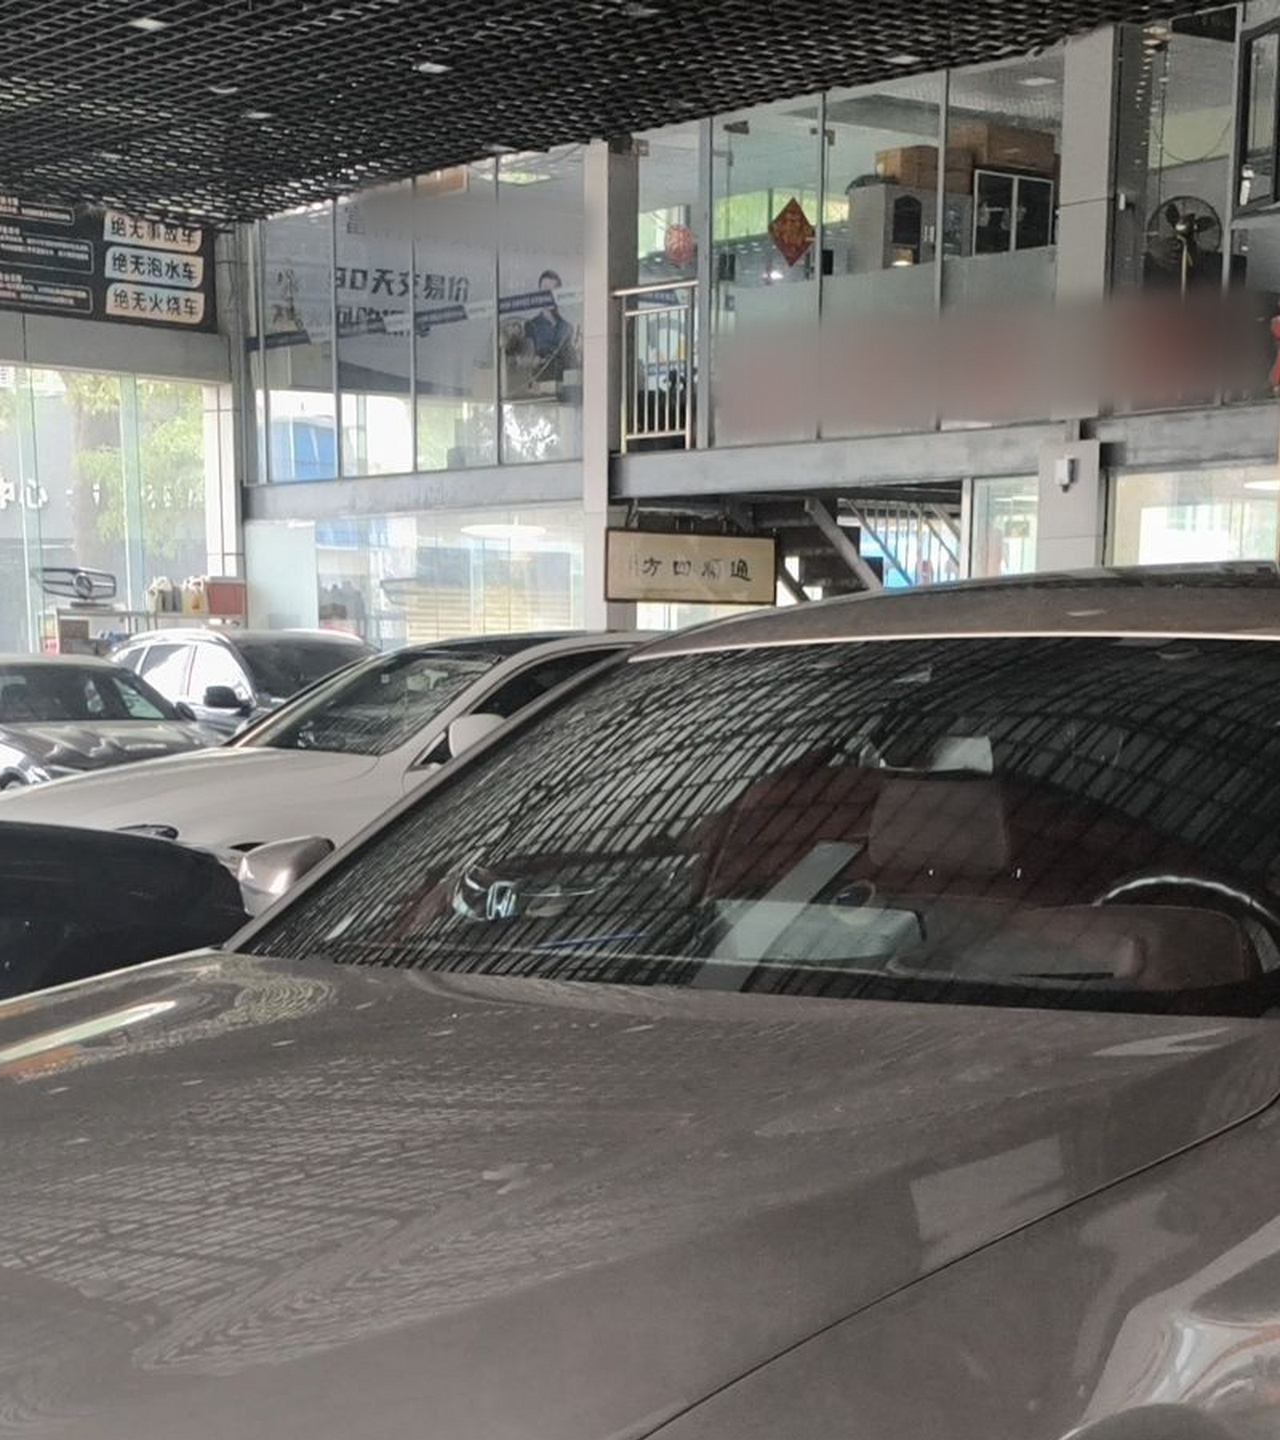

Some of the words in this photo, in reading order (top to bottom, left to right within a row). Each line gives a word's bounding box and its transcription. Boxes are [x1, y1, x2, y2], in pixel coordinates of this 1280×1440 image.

[112, 252, 198, 282] 绝无泡水车
[113, 289, 200, 317] 绝无火烧车
